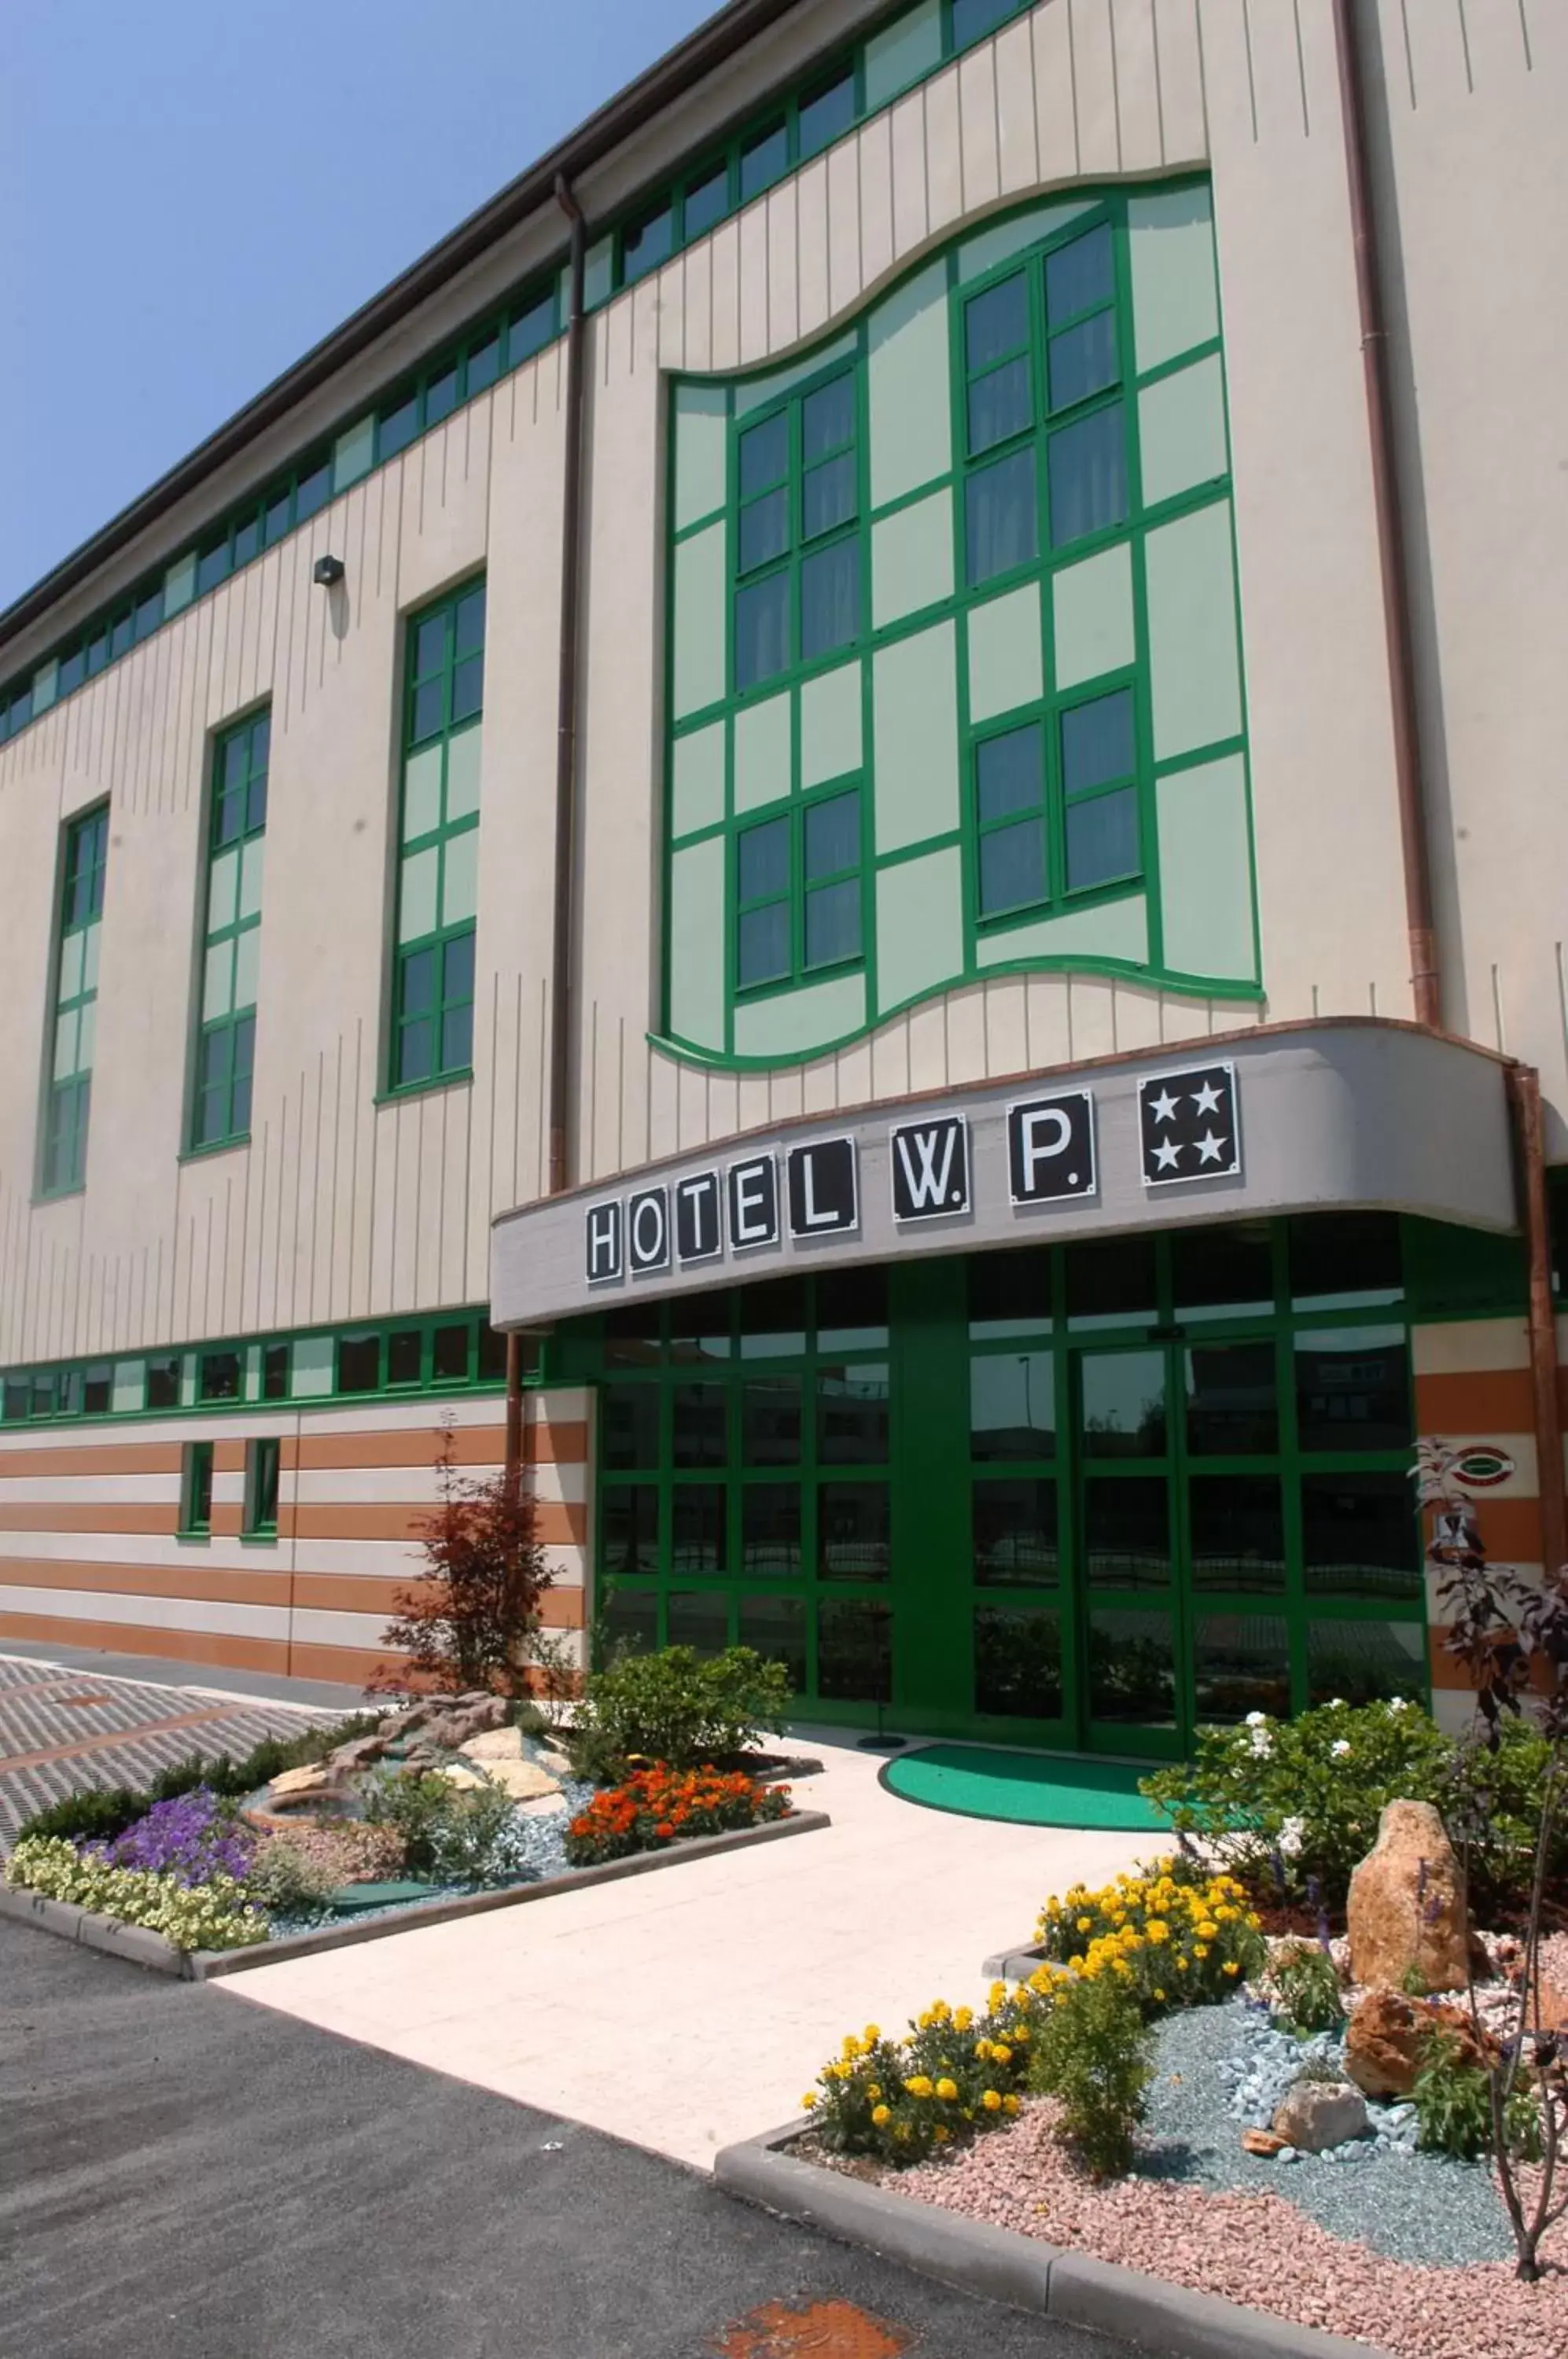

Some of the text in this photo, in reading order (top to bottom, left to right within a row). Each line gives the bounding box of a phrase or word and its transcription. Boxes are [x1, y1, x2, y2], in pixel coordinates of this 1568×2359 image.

[592, 1108, 1079, 1273] HOTEL W. P.
